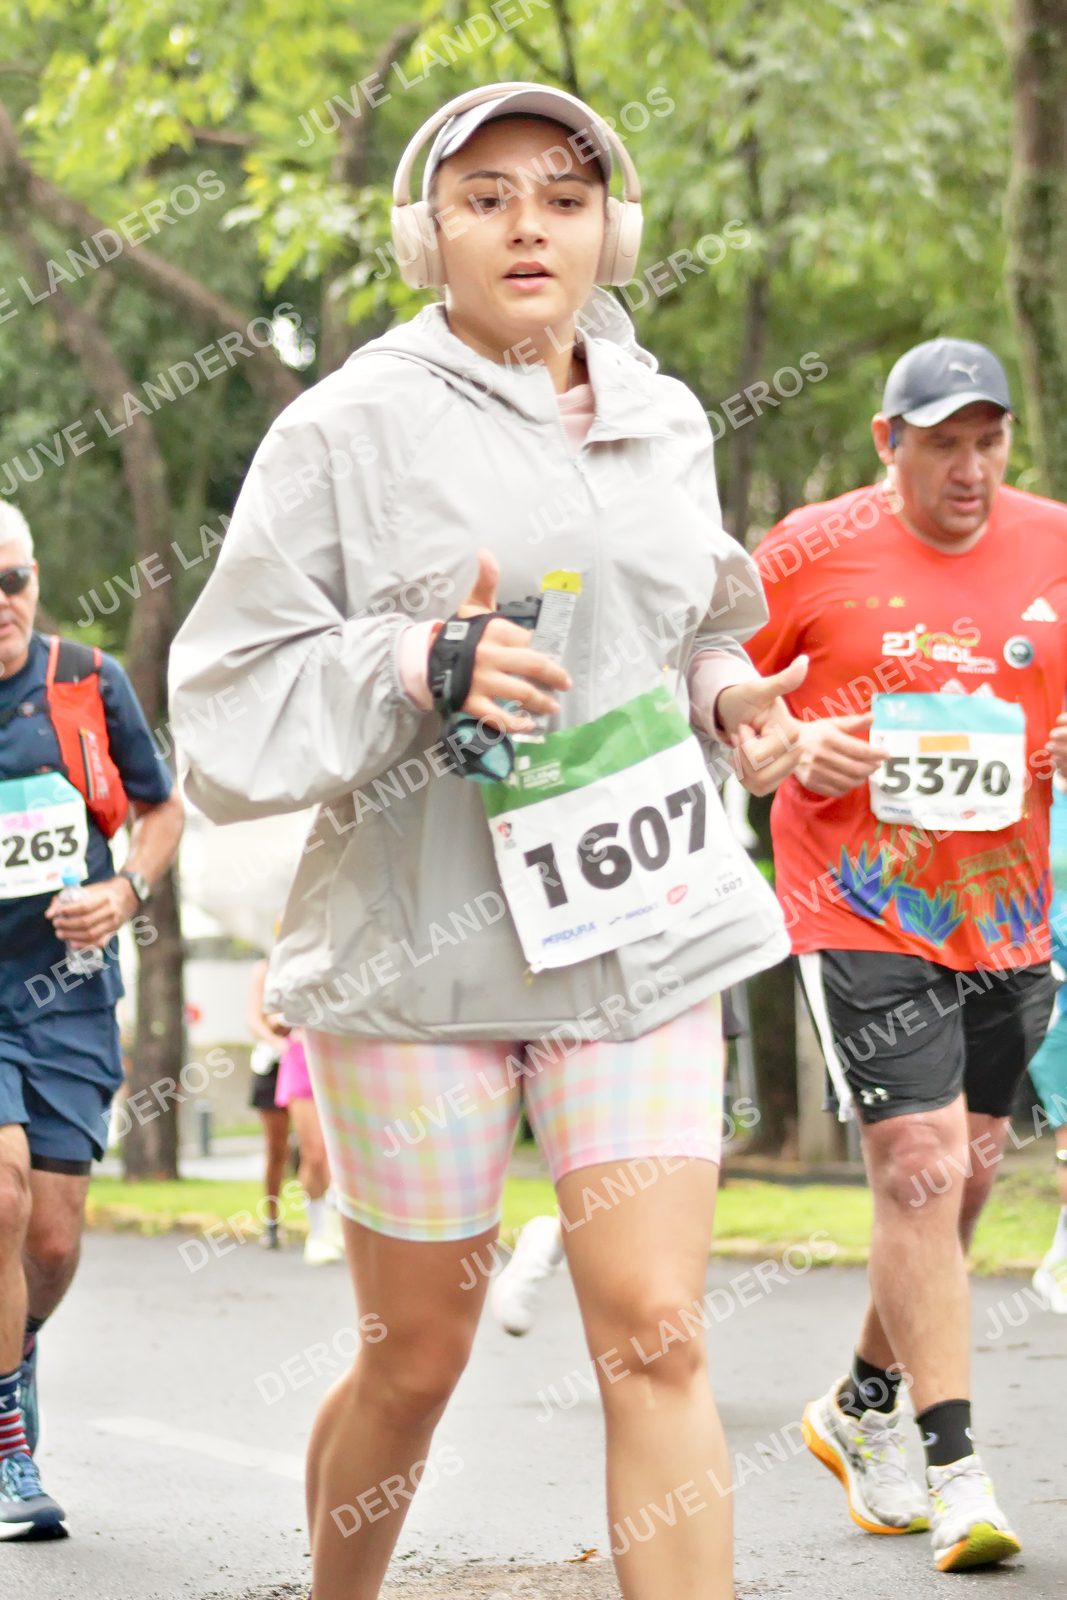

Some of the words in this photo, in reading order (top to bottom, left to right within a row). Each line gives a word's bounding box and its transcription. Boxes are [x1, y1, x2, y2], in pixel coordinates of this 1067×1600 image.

[880, 757, 1011, 796] 5370
[524, 781, 706, 909] 1607
[714, 877, 744, 898] 1607
